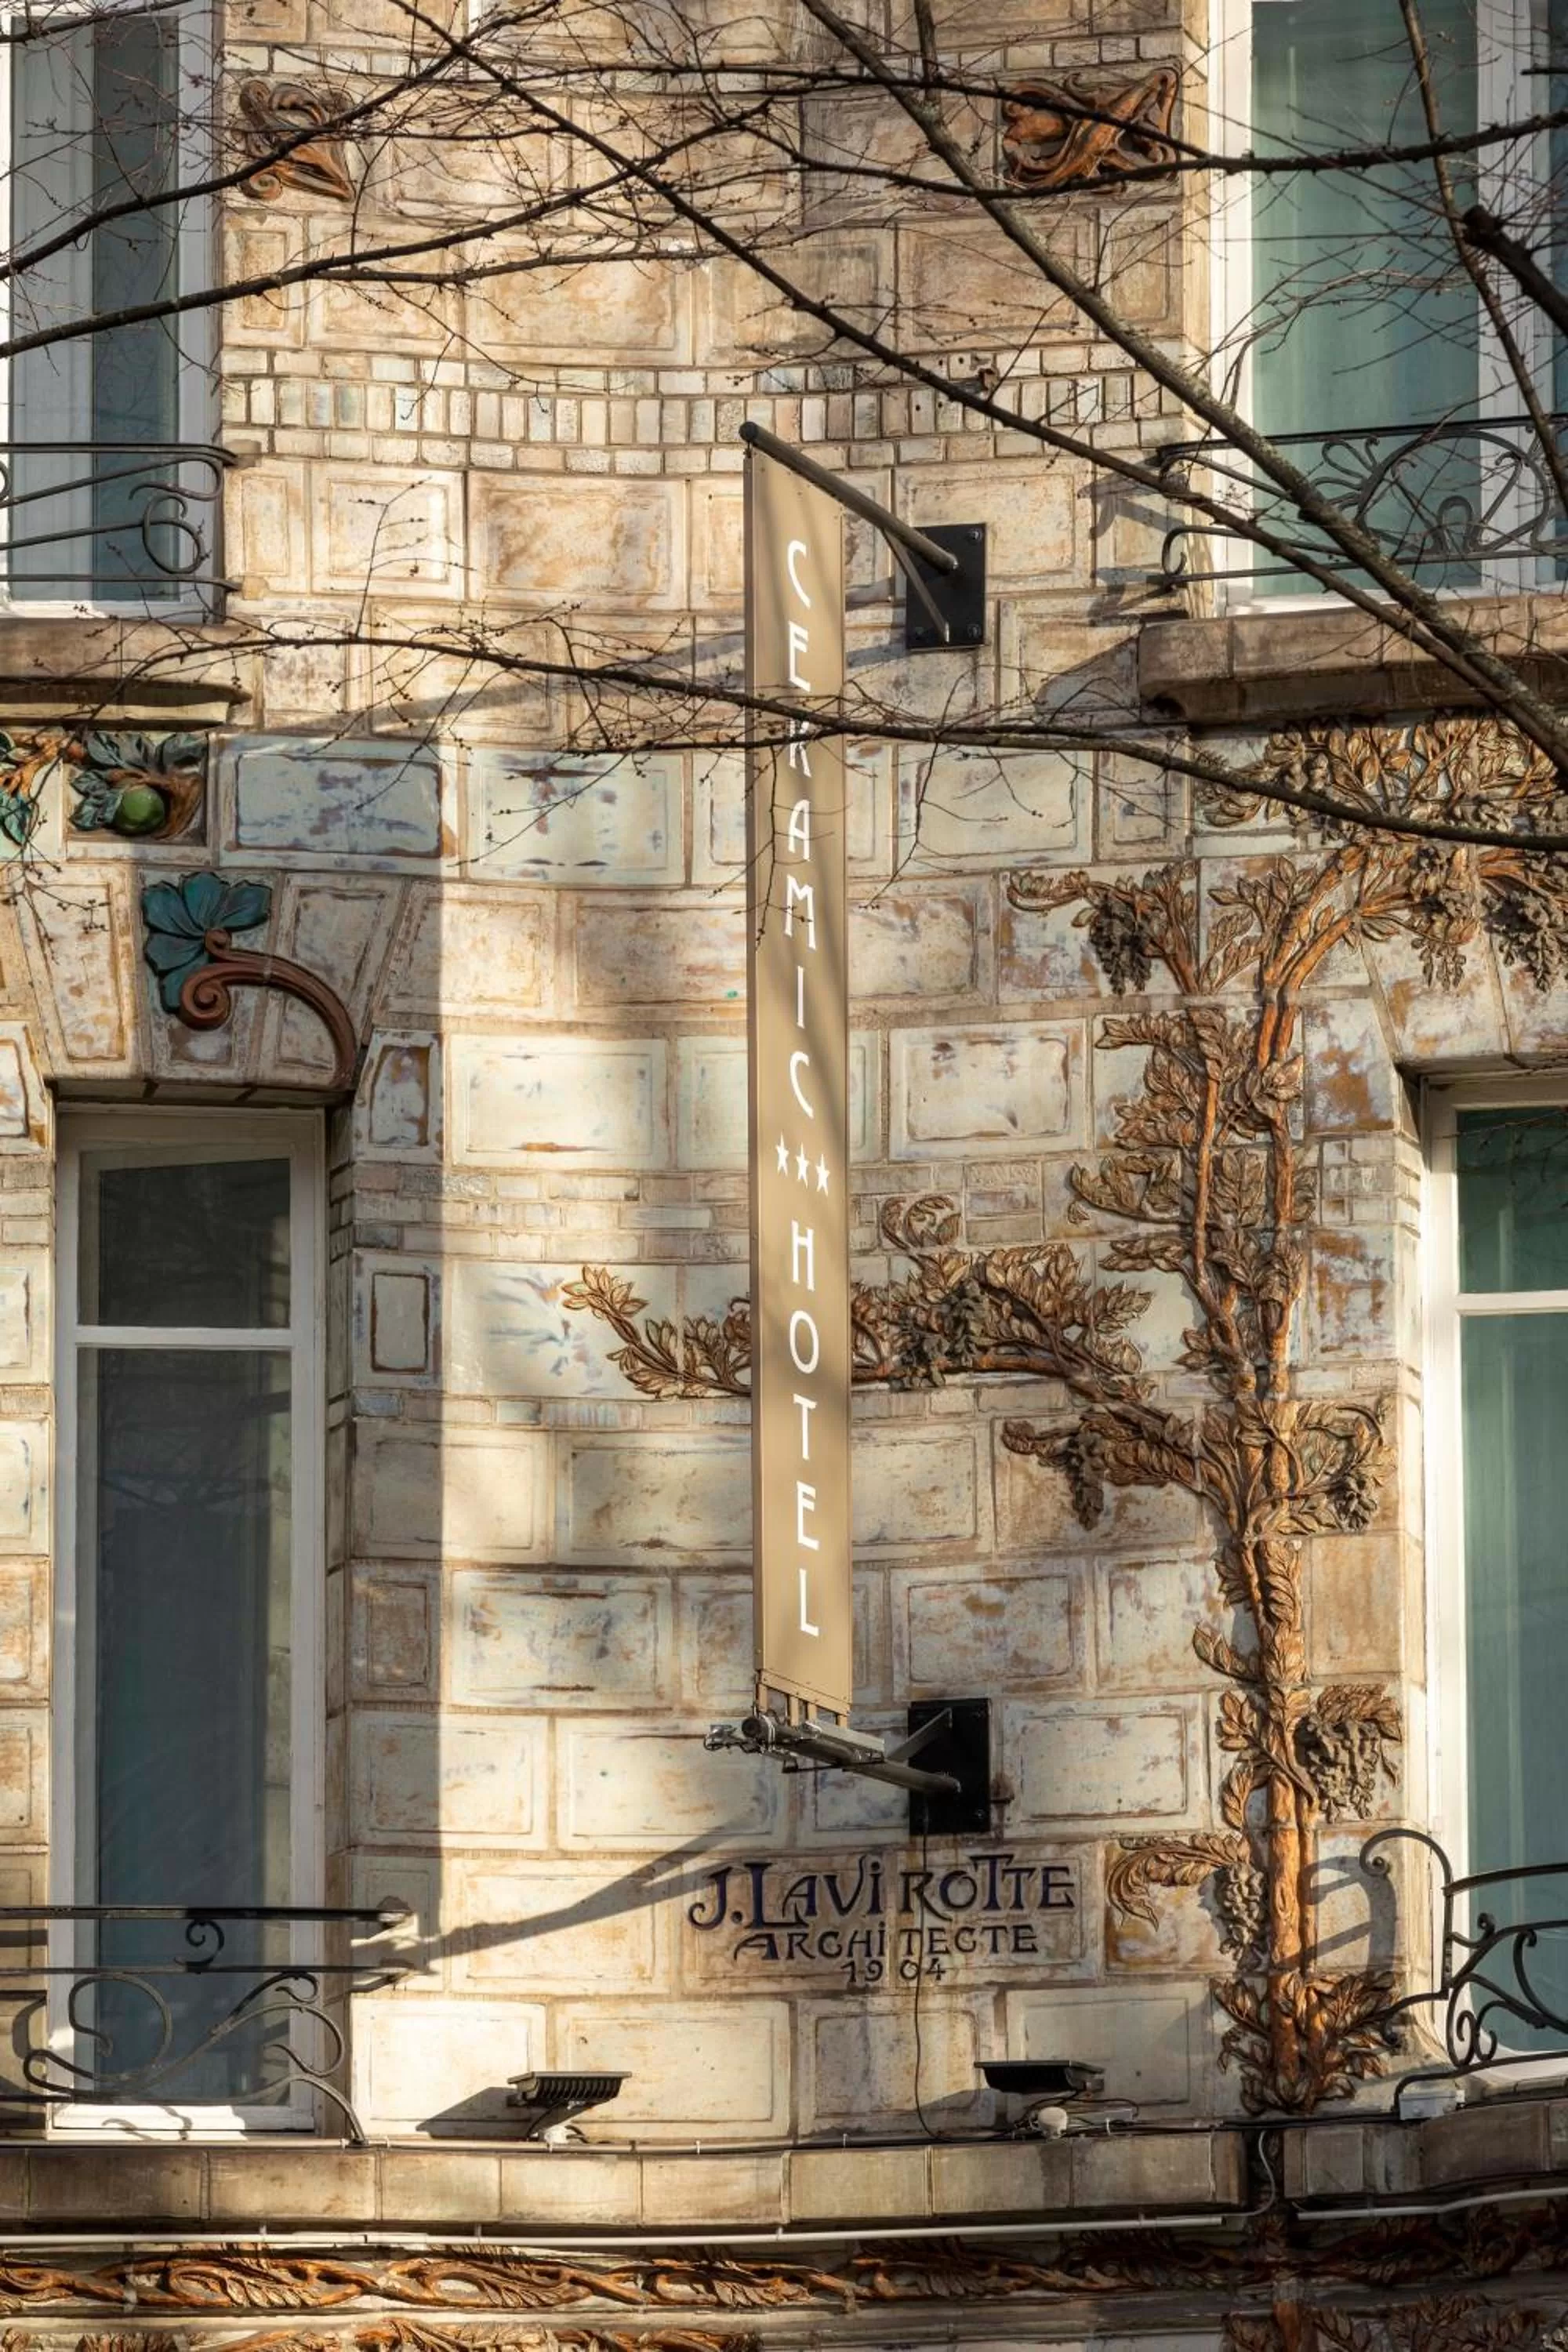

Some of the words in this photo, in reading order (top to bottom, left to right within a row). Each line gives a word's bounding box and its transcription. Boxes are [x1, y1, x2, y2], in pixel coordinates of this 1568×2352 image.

[785, 539, 816, 1120] CERAMIC
[789, 1220, 819, 1636] HOTEL
[840, 1958, 946, 1984] 1904
